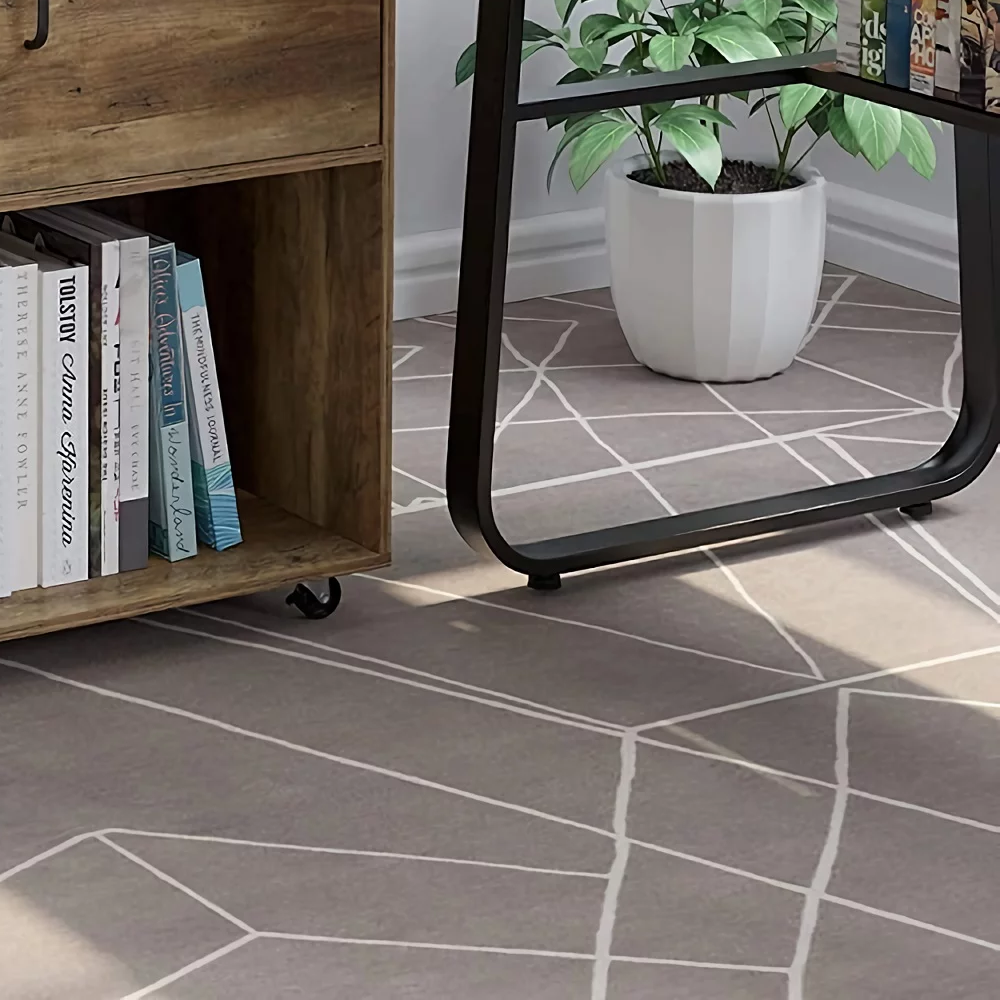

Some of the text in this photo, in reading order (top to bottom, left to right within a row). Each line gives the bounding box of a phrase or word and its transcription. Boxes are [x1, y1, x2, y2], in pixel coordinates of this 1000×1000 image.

[16, 271, 29, 510] THERESE ANNE FOWLER
[56, 275, 77, 548] TOLSTOY Anna Karenina
[166, 427, 193, 554] Wonderland
